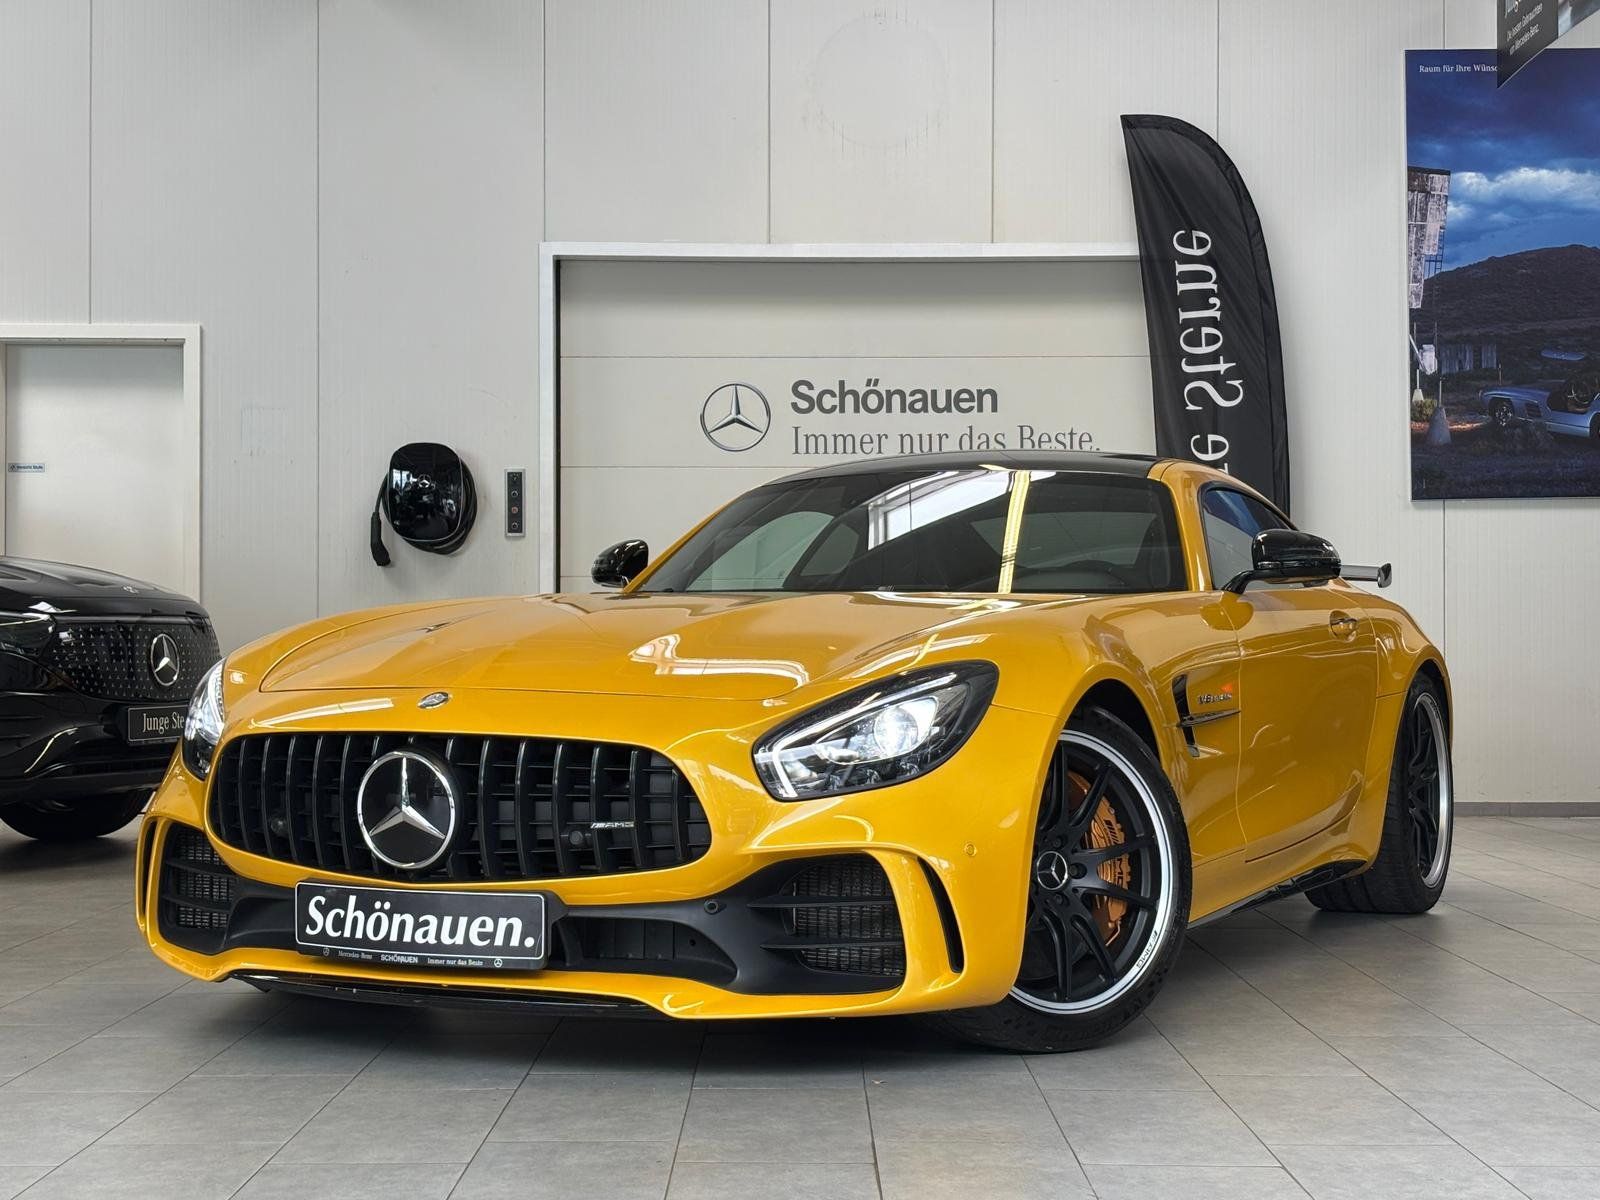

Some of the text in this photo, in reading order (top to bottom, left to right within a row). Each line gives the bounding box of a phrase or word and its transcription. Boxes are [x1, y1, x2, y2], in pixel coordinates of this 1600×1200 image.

[1419, 65, 1441, 73] Raum
[1443, 64, 1455, 72] für
[1456, 64, 1472, 72] Ihre
[790, 378, 998, 414] Schönauen
[792, 426, 889, 455] Immer
[898, 433, 949, 454] nur
[959, 425, 1007, 450] das
[142, 713, 169, 735] Junge
[305, 895, 535, 948] Schönauen.
